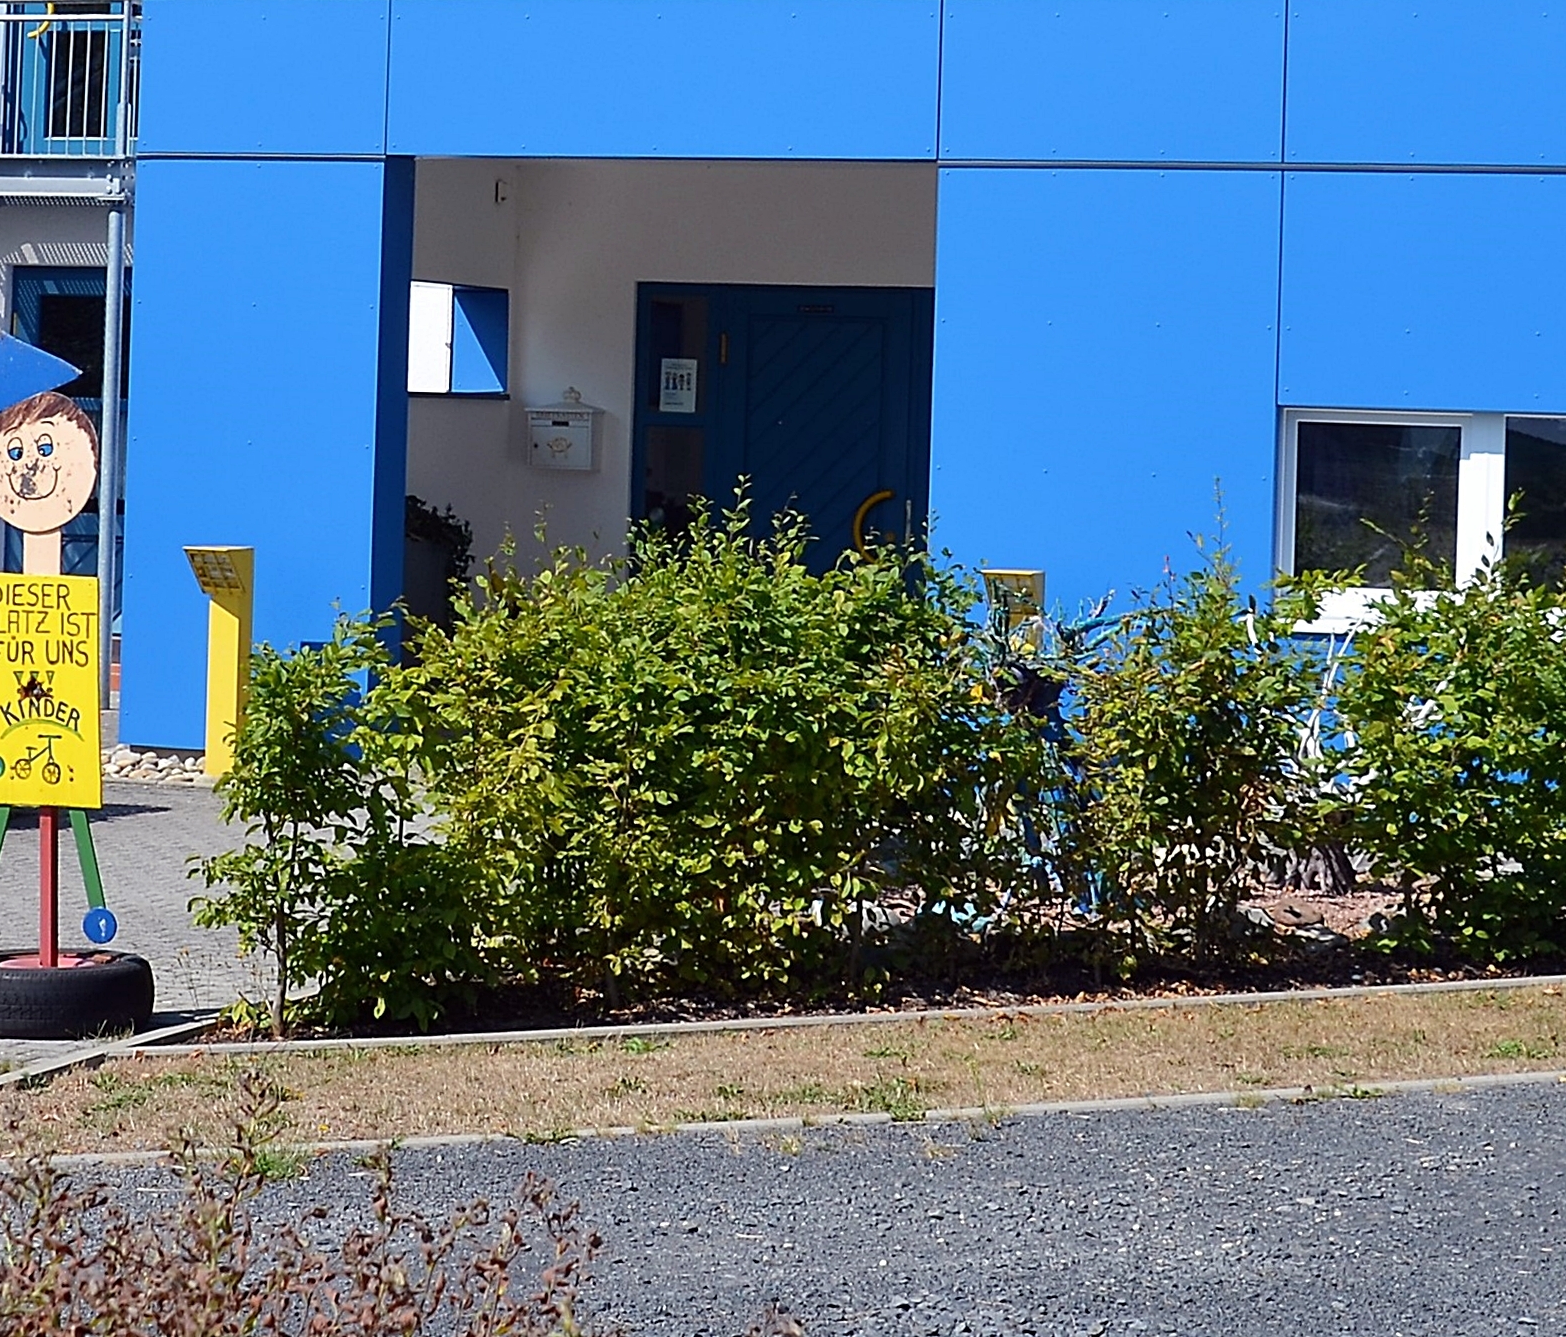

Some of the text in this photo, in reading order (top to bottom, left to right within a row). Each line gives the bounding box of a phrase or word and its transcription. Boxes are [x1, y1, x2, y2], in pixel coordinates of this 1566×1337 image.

[60, 612, 97, 638] IST
[46, 639, 89, 667] UNS
[0, 697, 81, 732] KINDER
